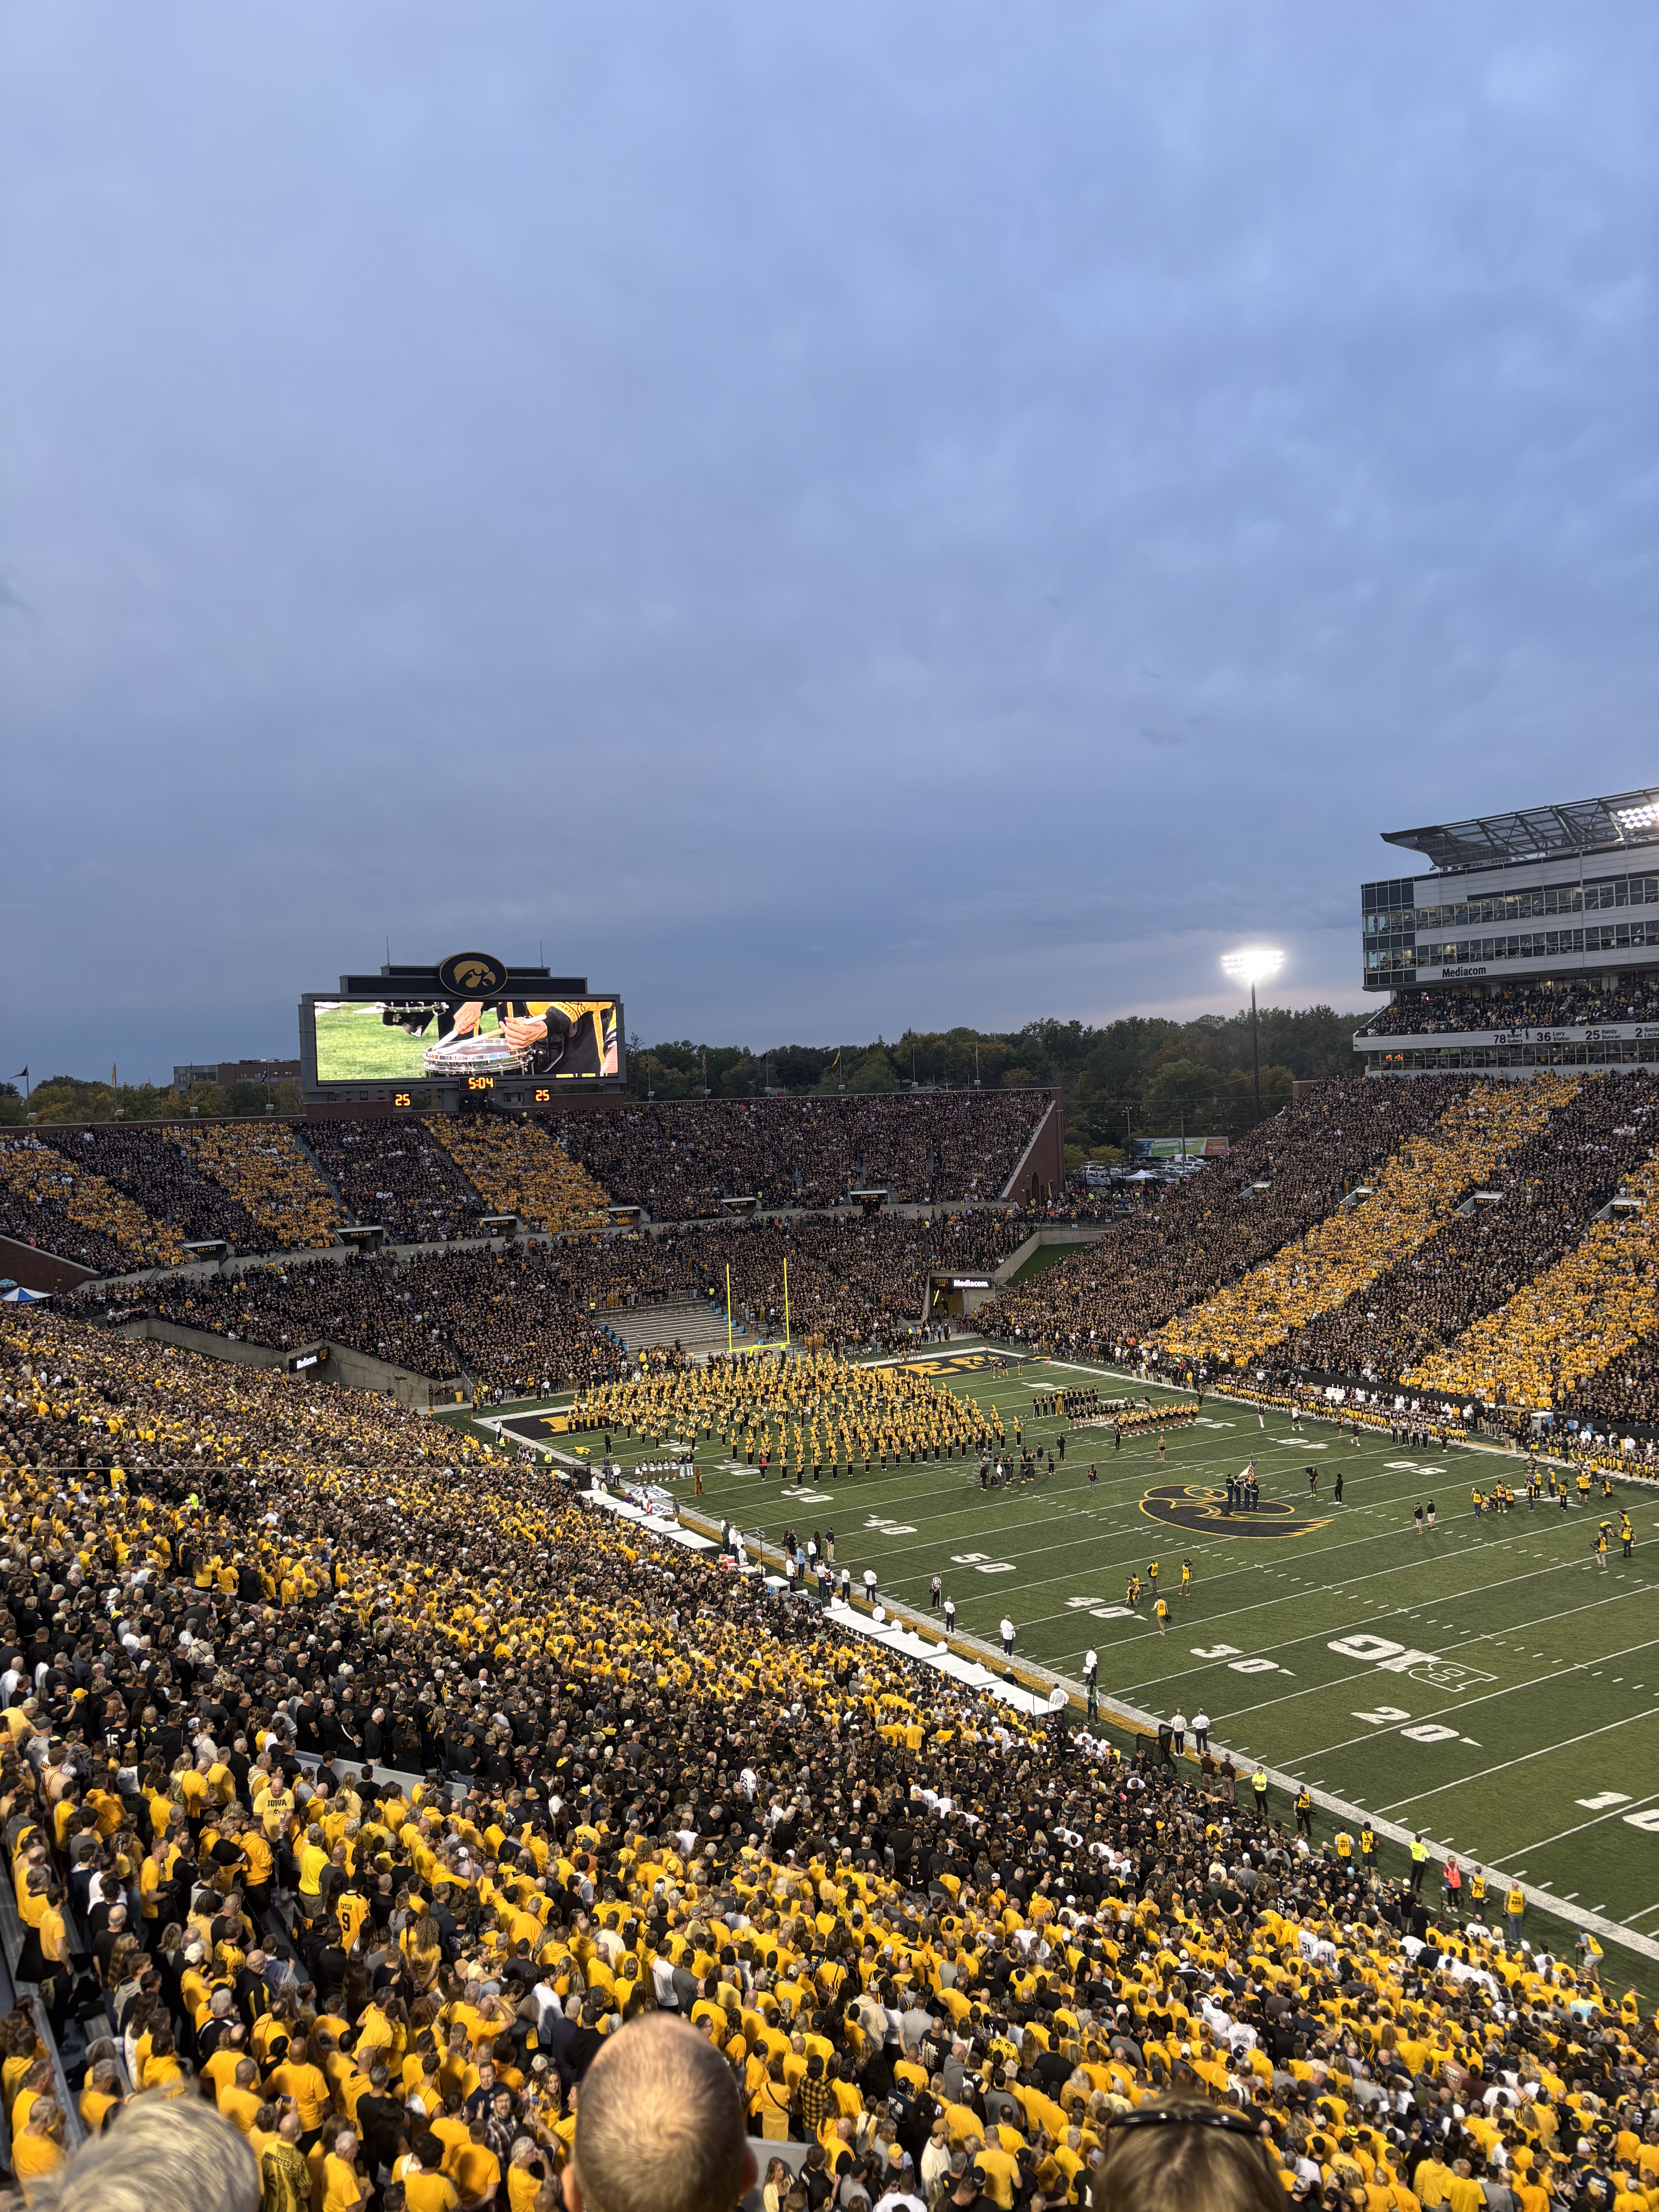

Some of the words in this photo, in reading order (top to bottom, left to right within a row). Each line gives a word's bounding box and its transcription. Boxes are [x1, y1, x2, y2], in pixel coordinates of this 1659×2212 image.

[1443, 967, 1486, 977] Mediacom
[1537, 1032, 1551, 1042] 36
[1585, 1030, 1600, 1040] 25
[1635, 1027, 1643, 1037] 2
[1493, 1034, 1506, 1044] 78
[468, 1077, 493, 1089] 5:04
[395, 1094, 410, 1106] 25
[536, 1089, 550, 1101] 25
[1383, 1461, 1448, 1475] 50
[780, 1488, 835, 1503] 30
[862, 1519, 918, 1535] 40
[950, 1553, 1017, 1573] 50
[1064, 1597, 1135, 1618] 40
[1190, 1644, 1279, 1673] 30
[1350, 1706, 1460, 1742] 20
[106, 1734, 118, 1747] 15
[1574, 1791, 1659, 1832] 10
[342, 1912, 350, 1932] 9
